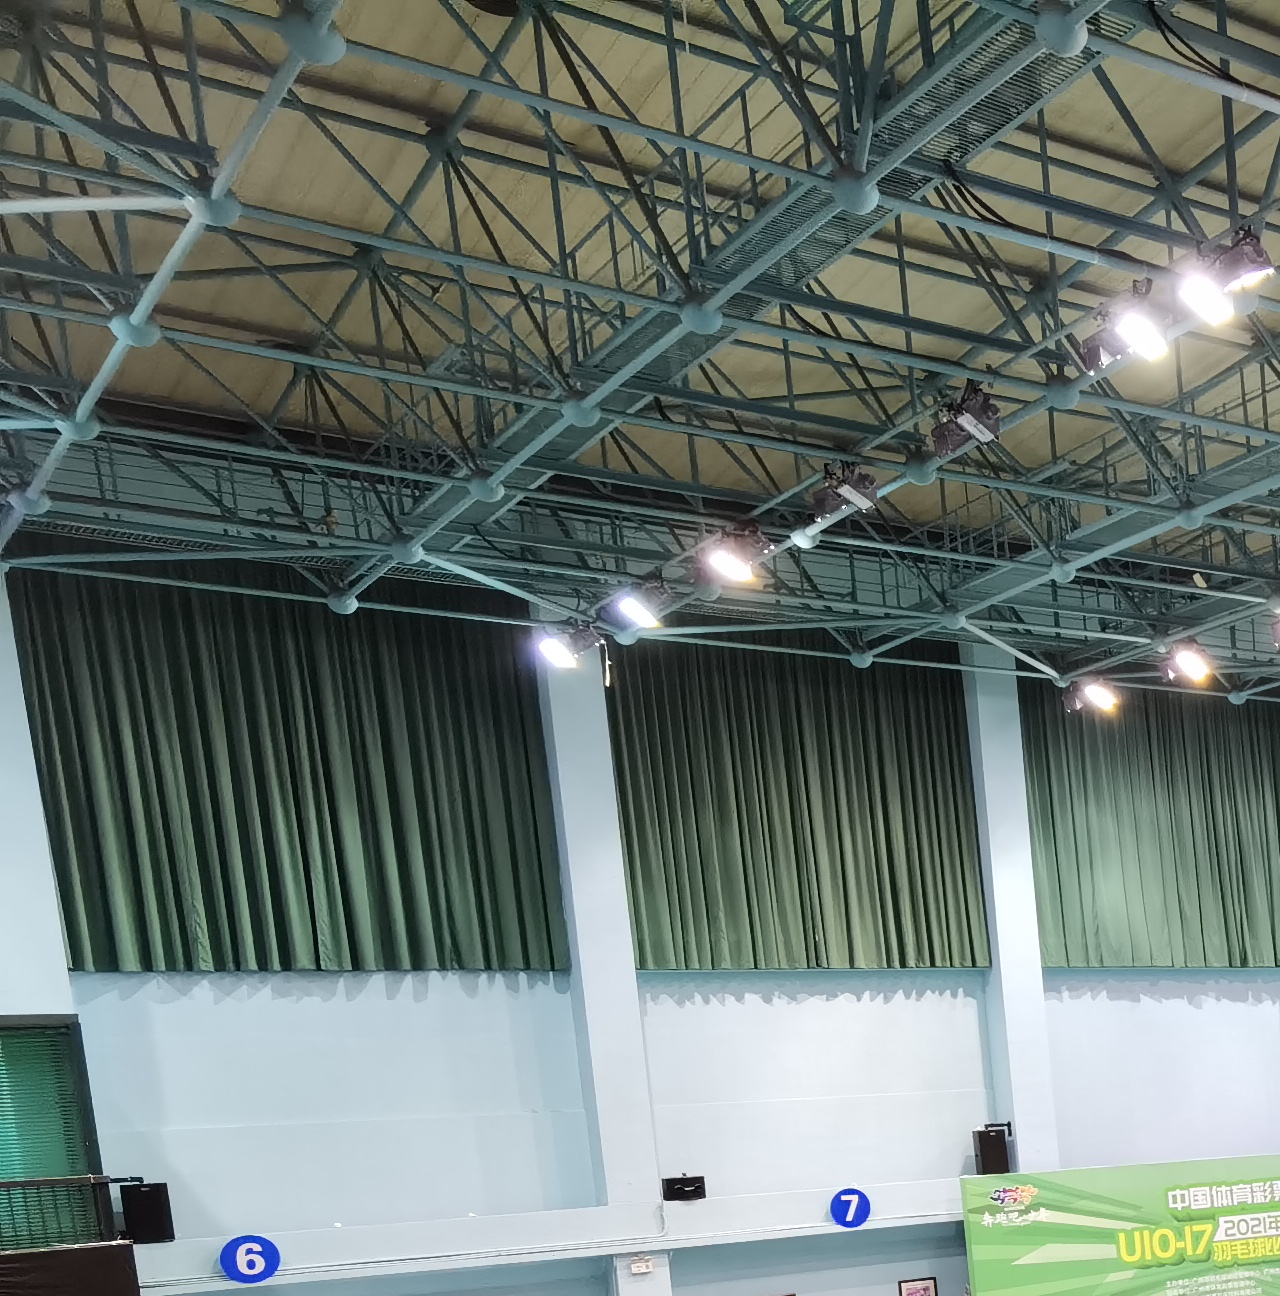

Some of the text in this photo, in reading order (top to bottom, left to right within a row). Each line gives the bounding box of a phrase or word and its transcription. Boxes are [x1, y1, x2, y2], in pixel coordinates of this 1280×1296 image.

[840, 1194, 860, 1221] 7
[235, 1243, 265, 1275] 6
[1118, 1223, 1213, 1263] U10-17
